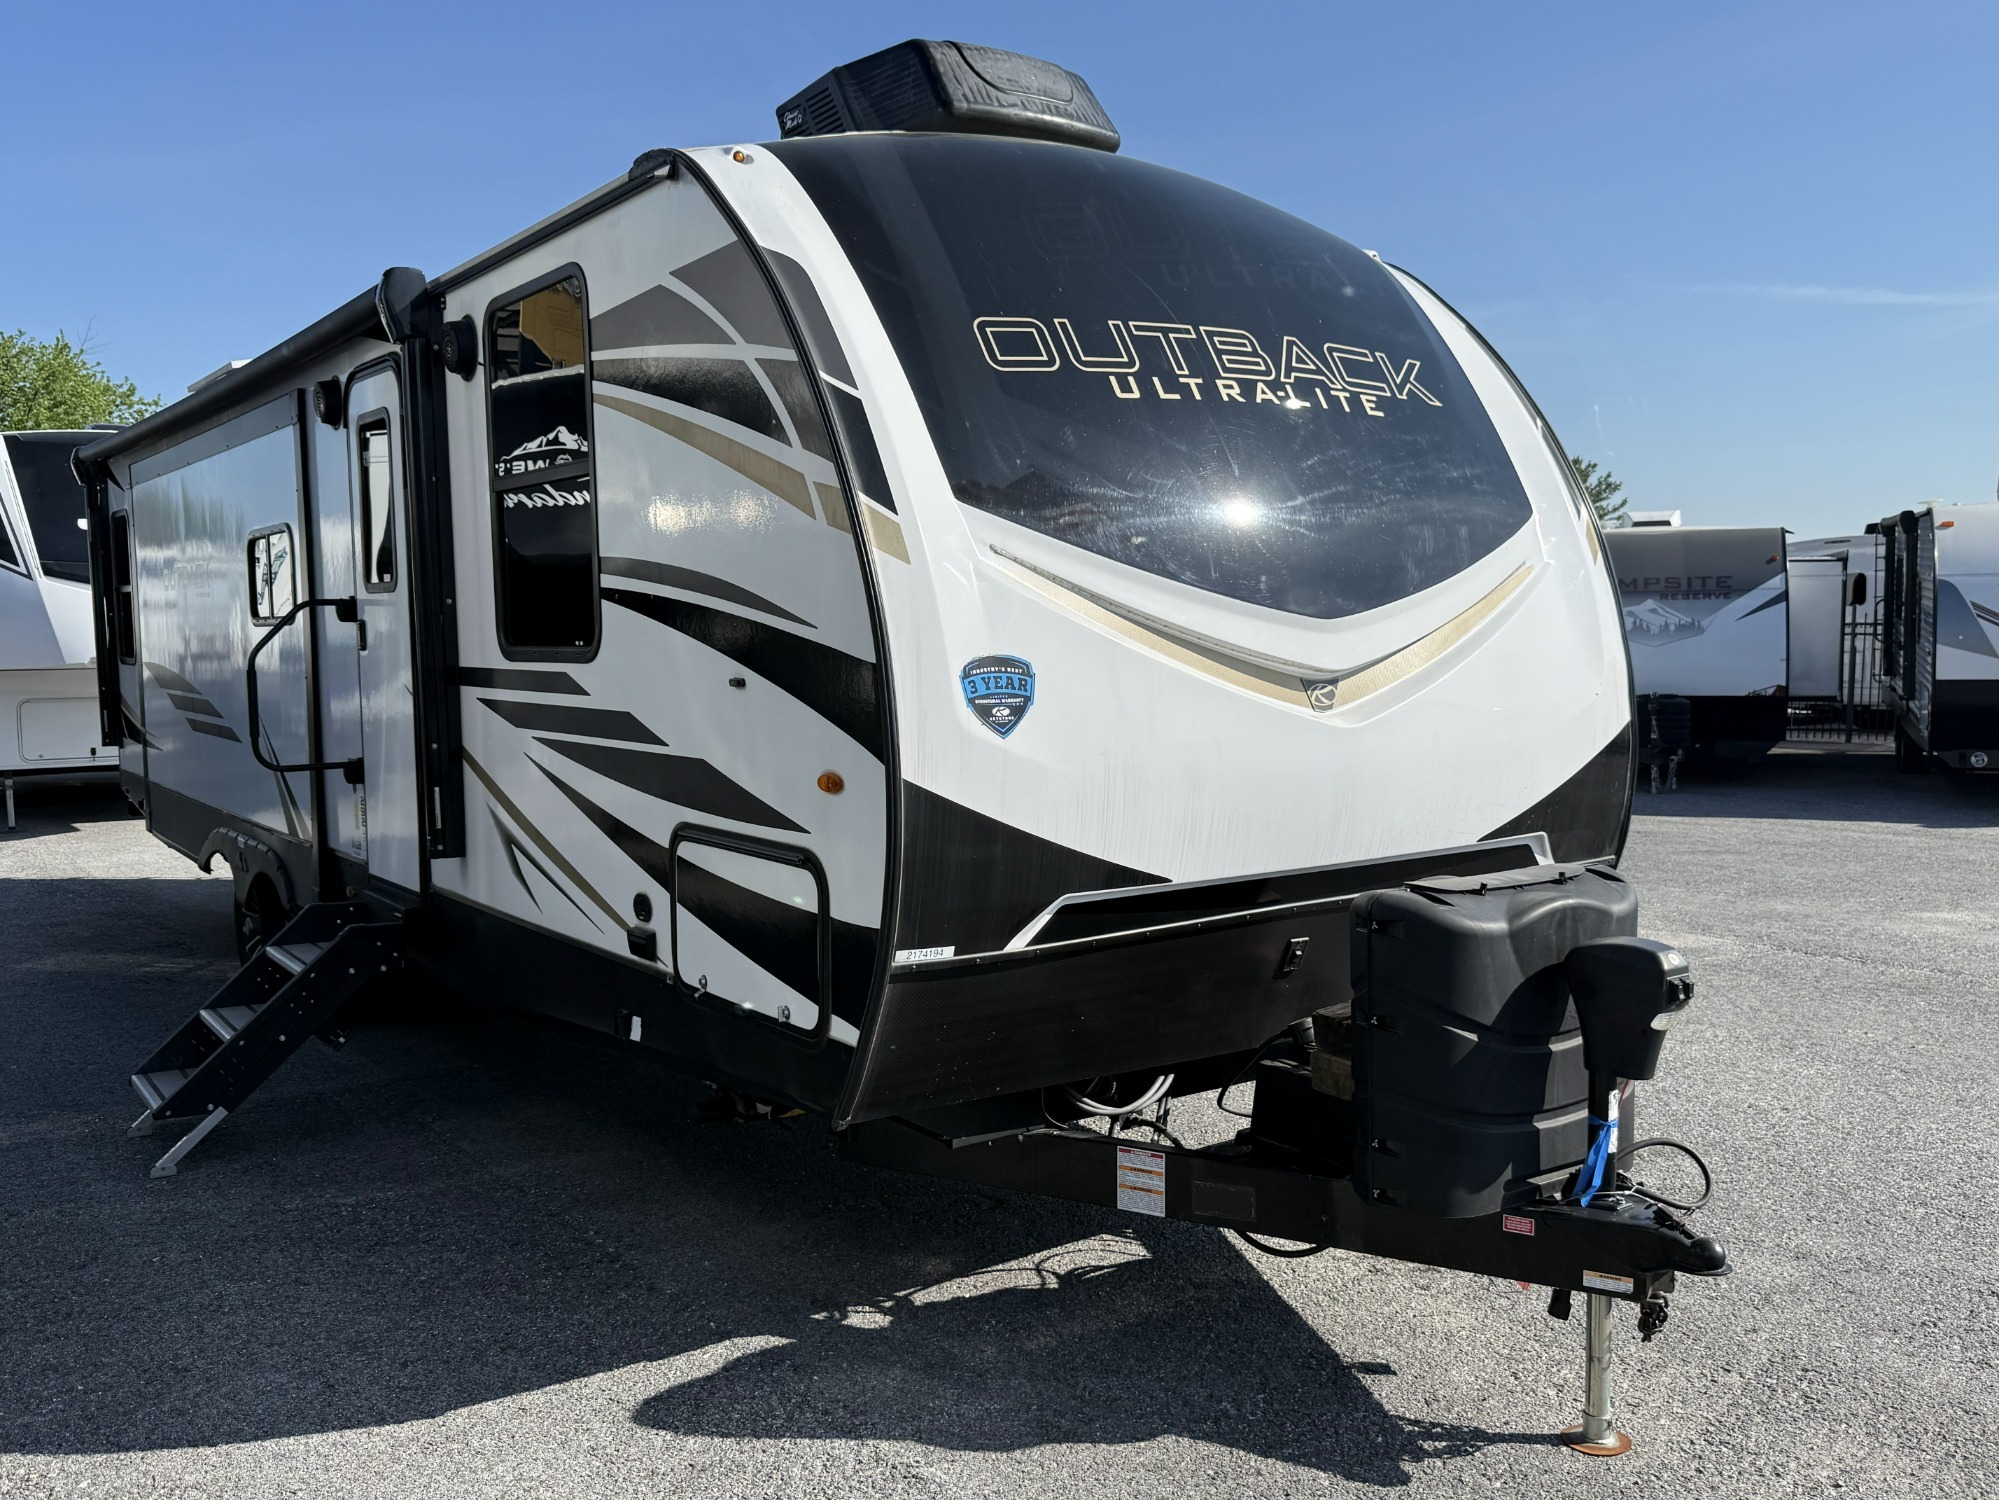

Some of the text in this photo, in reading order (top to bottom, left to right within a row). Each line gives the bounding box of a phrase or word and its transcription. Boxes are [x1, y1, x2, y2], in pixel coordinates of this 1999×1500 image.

[973, 316, 1443, 407] OUTBACK
[1109, 375, 1385, 418] ULTRA-LITE
[1618, 575, 1733, 590] MPSITE
[1660, 591, 1732, 601] RESERVE
[968, 676, 1028, 694] 3 YEAR
[906, 949, 944, 960] 2174194
